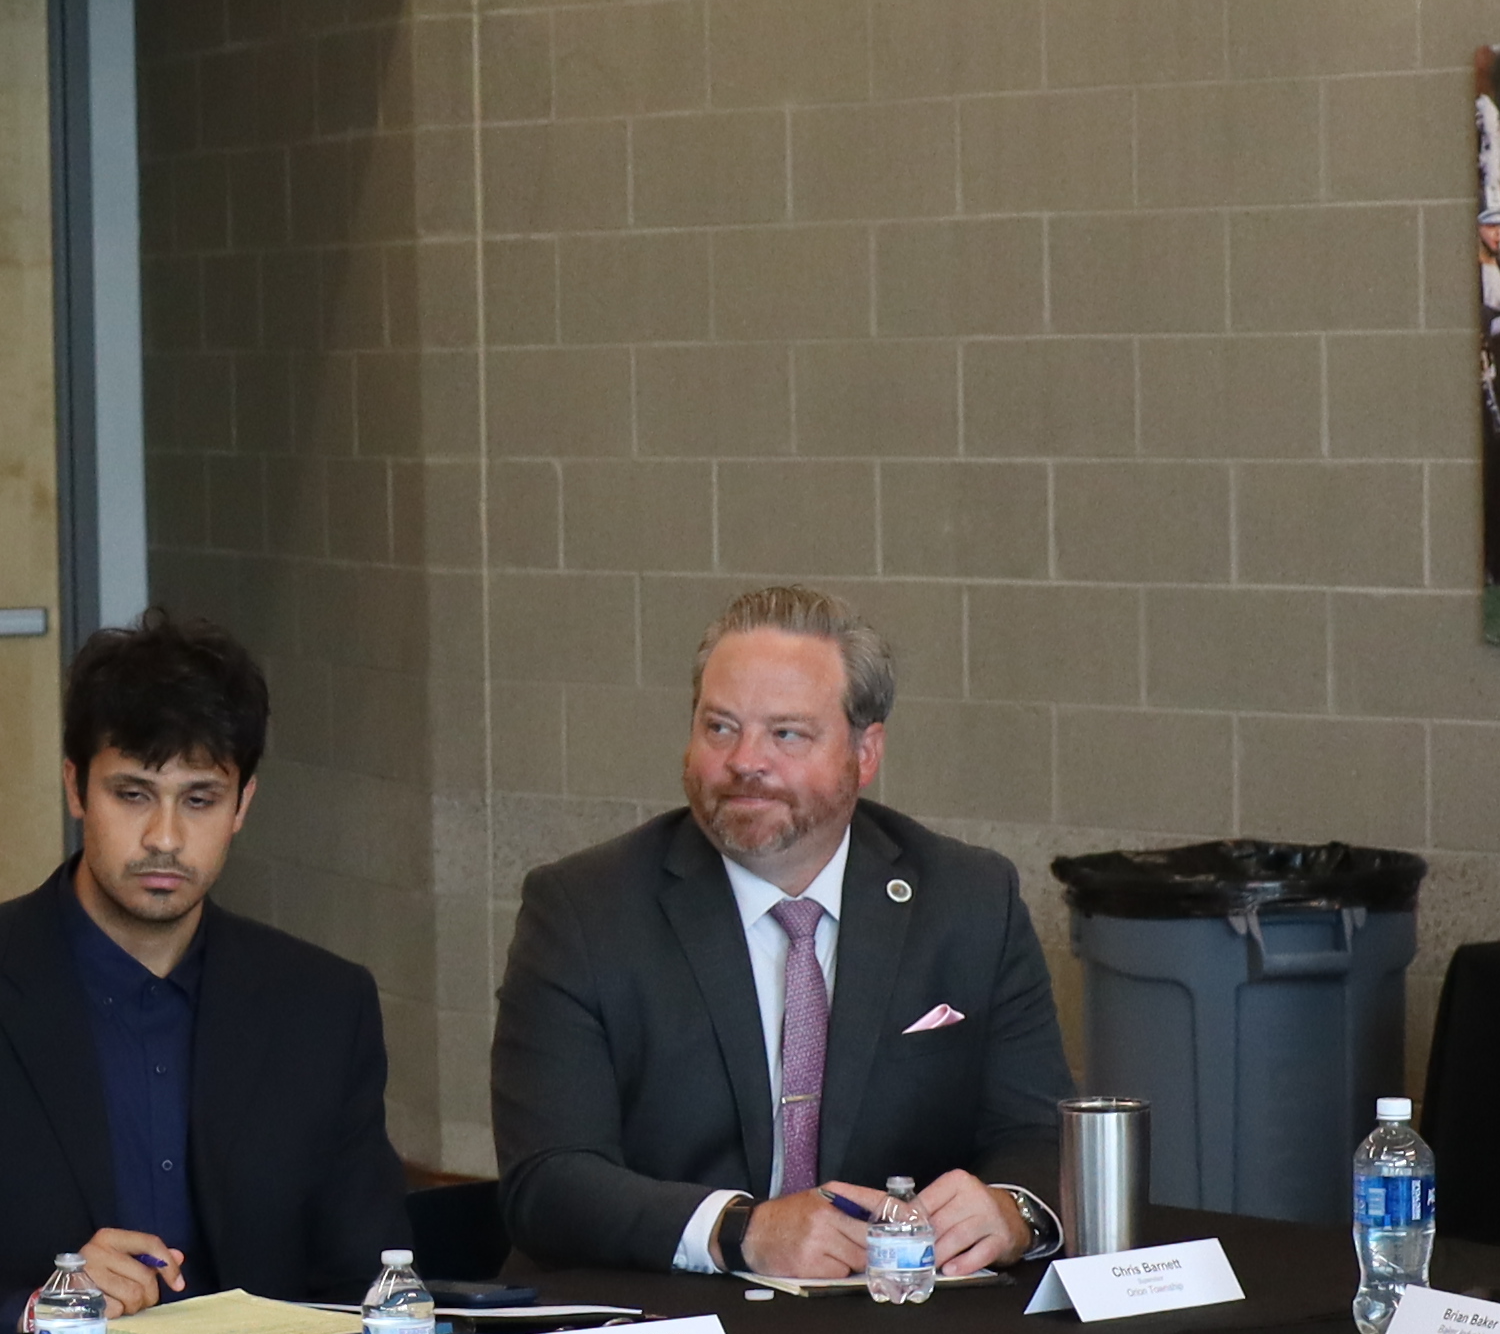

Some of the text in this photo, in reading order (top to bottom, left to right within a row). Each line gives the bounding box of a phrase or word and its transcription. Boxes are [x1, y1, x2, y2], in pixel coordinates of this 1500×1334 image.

[1111, 1258, 1182, 1278] Chris Barnett
[1443, 1308, 1499, 1330] Brian Baker
